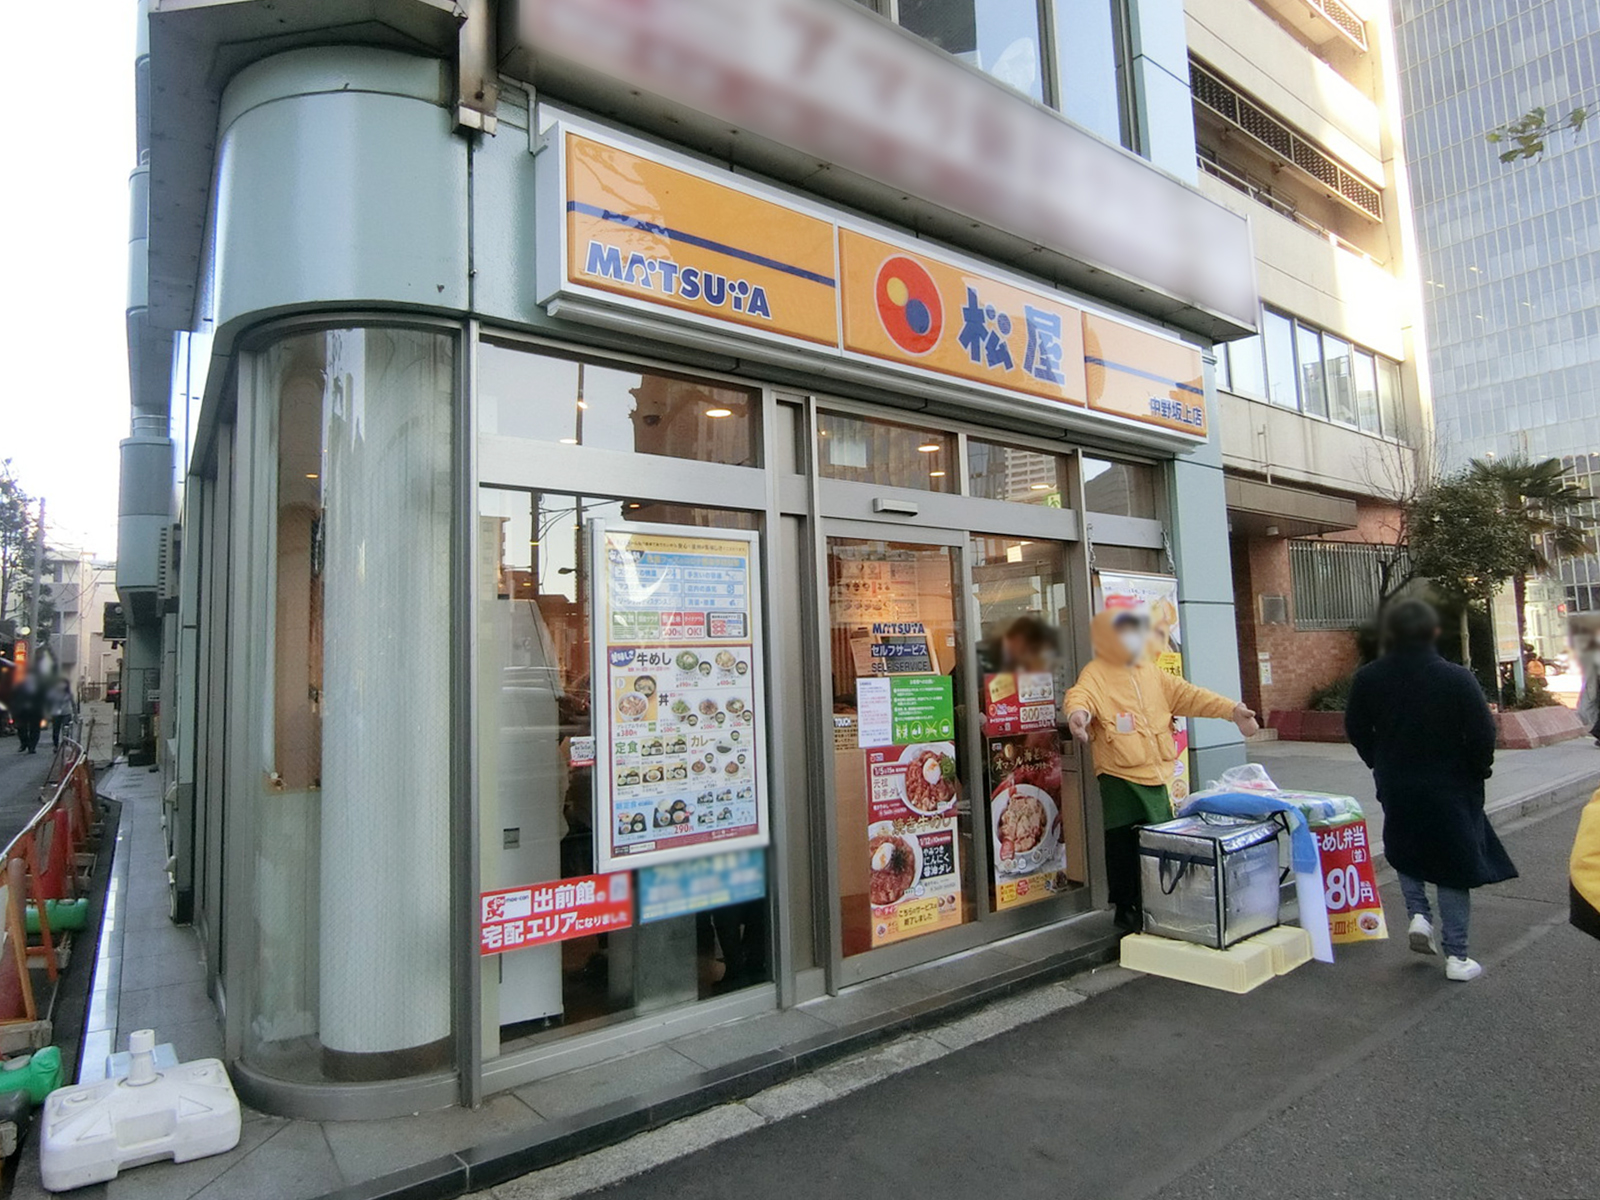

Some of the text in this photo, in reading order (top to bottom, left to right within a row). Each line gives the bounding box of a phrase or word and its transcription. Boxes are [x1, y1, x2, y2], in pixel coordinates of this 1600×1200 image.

[584, 239, 772, 320] MATSUYA
[957, 284, 1066, 387] 松屋
[1150, 397, 1202, 426] 中野坂上店
[871, 644, 928, 657] セルフサービス
[637, 652, 672, 666] 牛めし
[894, 661, 928, 672] SERVICE
[615, 740, 638, 755] 定食
[691, 735, 716, 748] カレー
[892, 814, 951, 836] 焼き牛めし
[924, 853, 950, 866] にんにく
